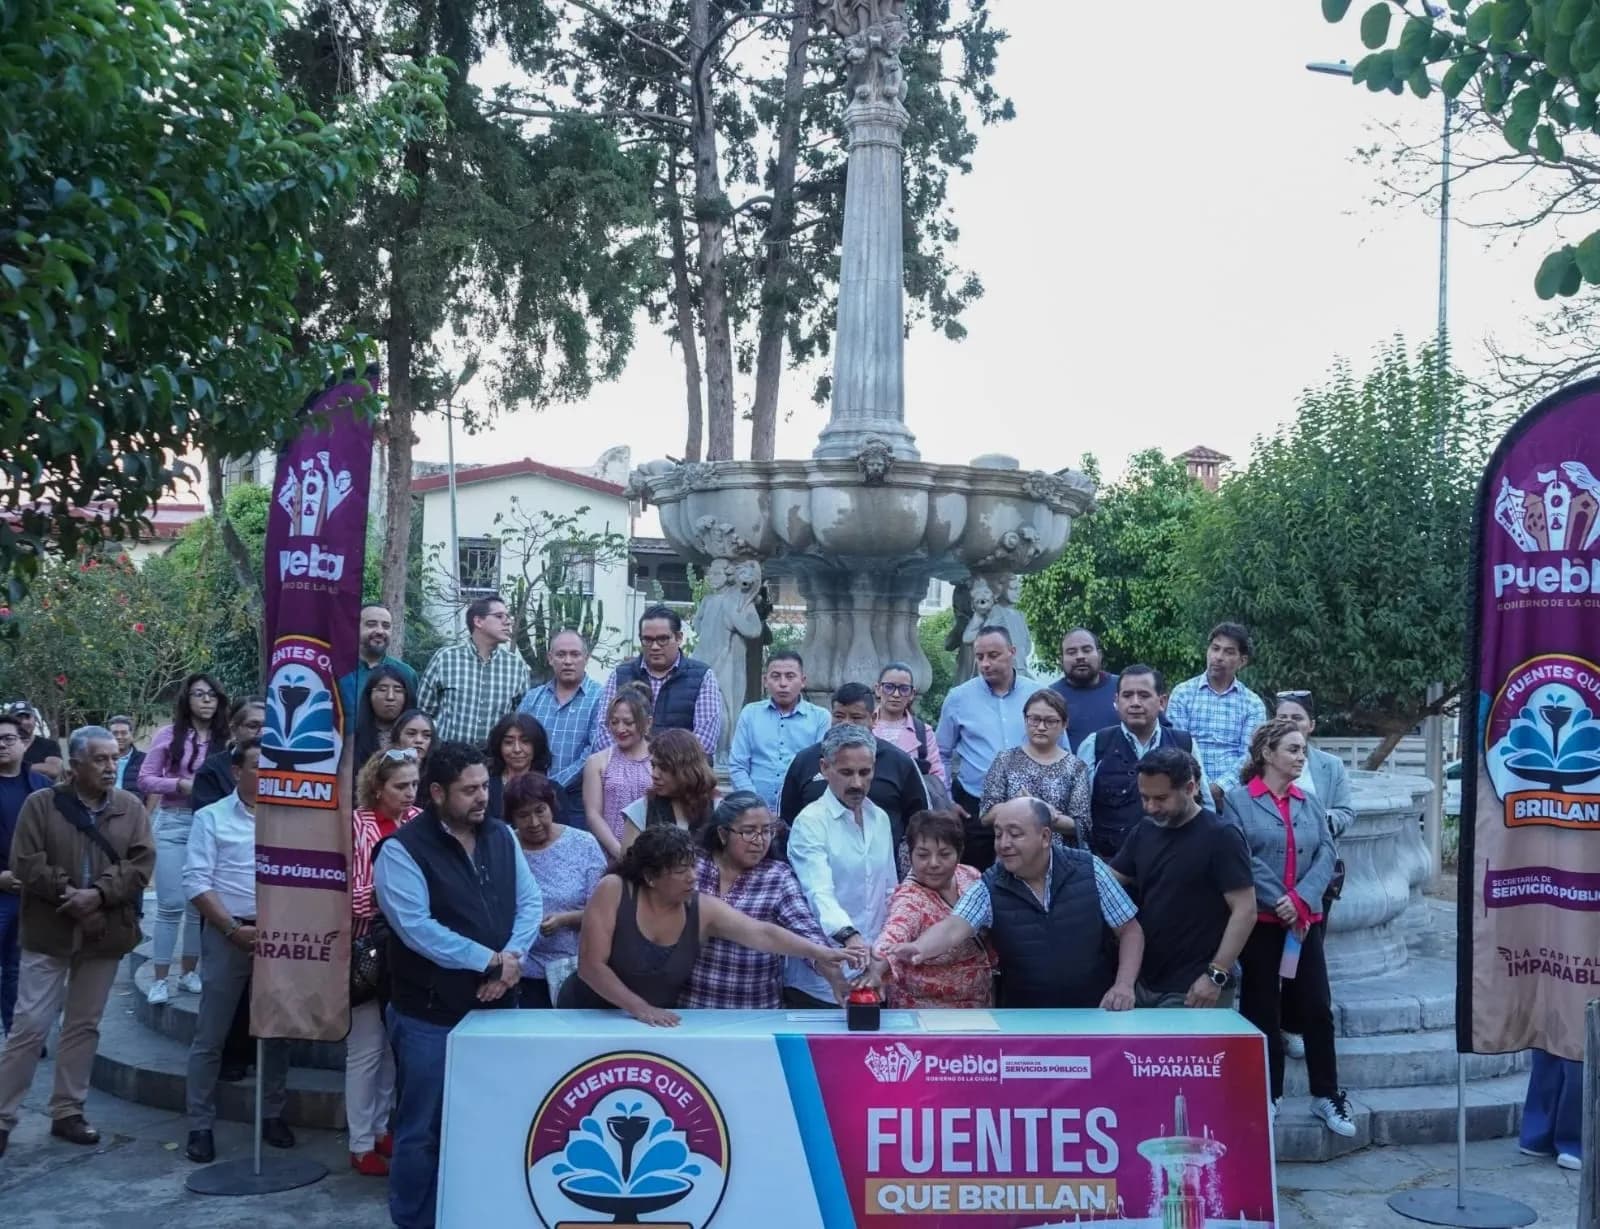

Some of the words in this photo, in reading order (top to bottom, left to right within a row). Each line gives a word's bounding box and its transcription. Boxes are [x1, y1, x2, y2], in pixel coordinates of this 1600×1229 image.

[1550, 599, 1564, 607] DE
[1567, 599, 1581, 607] LA
[1506, 665, 1575, 702] FUENTES
[1514, 799, 1599, 821] BRILLAN
[1541, 875, 1552, 883] DE
[1492, 883, 1558, 899] SERVICIOS
[1559, 886, 1600, 902] PÚBLI
[1514, 948, 1531, 960] LA
[925, 1054, 998, 1074] Puebla
[1049, 1064, 1088, 1073] PÚBLICOS
[1132, 1064, 1221, 1077] IMPARABLE
[563, 1066, 653, 1109] FUENTES
[655, 1074, 693, 1108] QUE
[867, 1107, 1120, 1174] FUENTES
[877, 1184, 950, 1214] QUE
[958, 1184, 1106, 1211] BRILLAN
